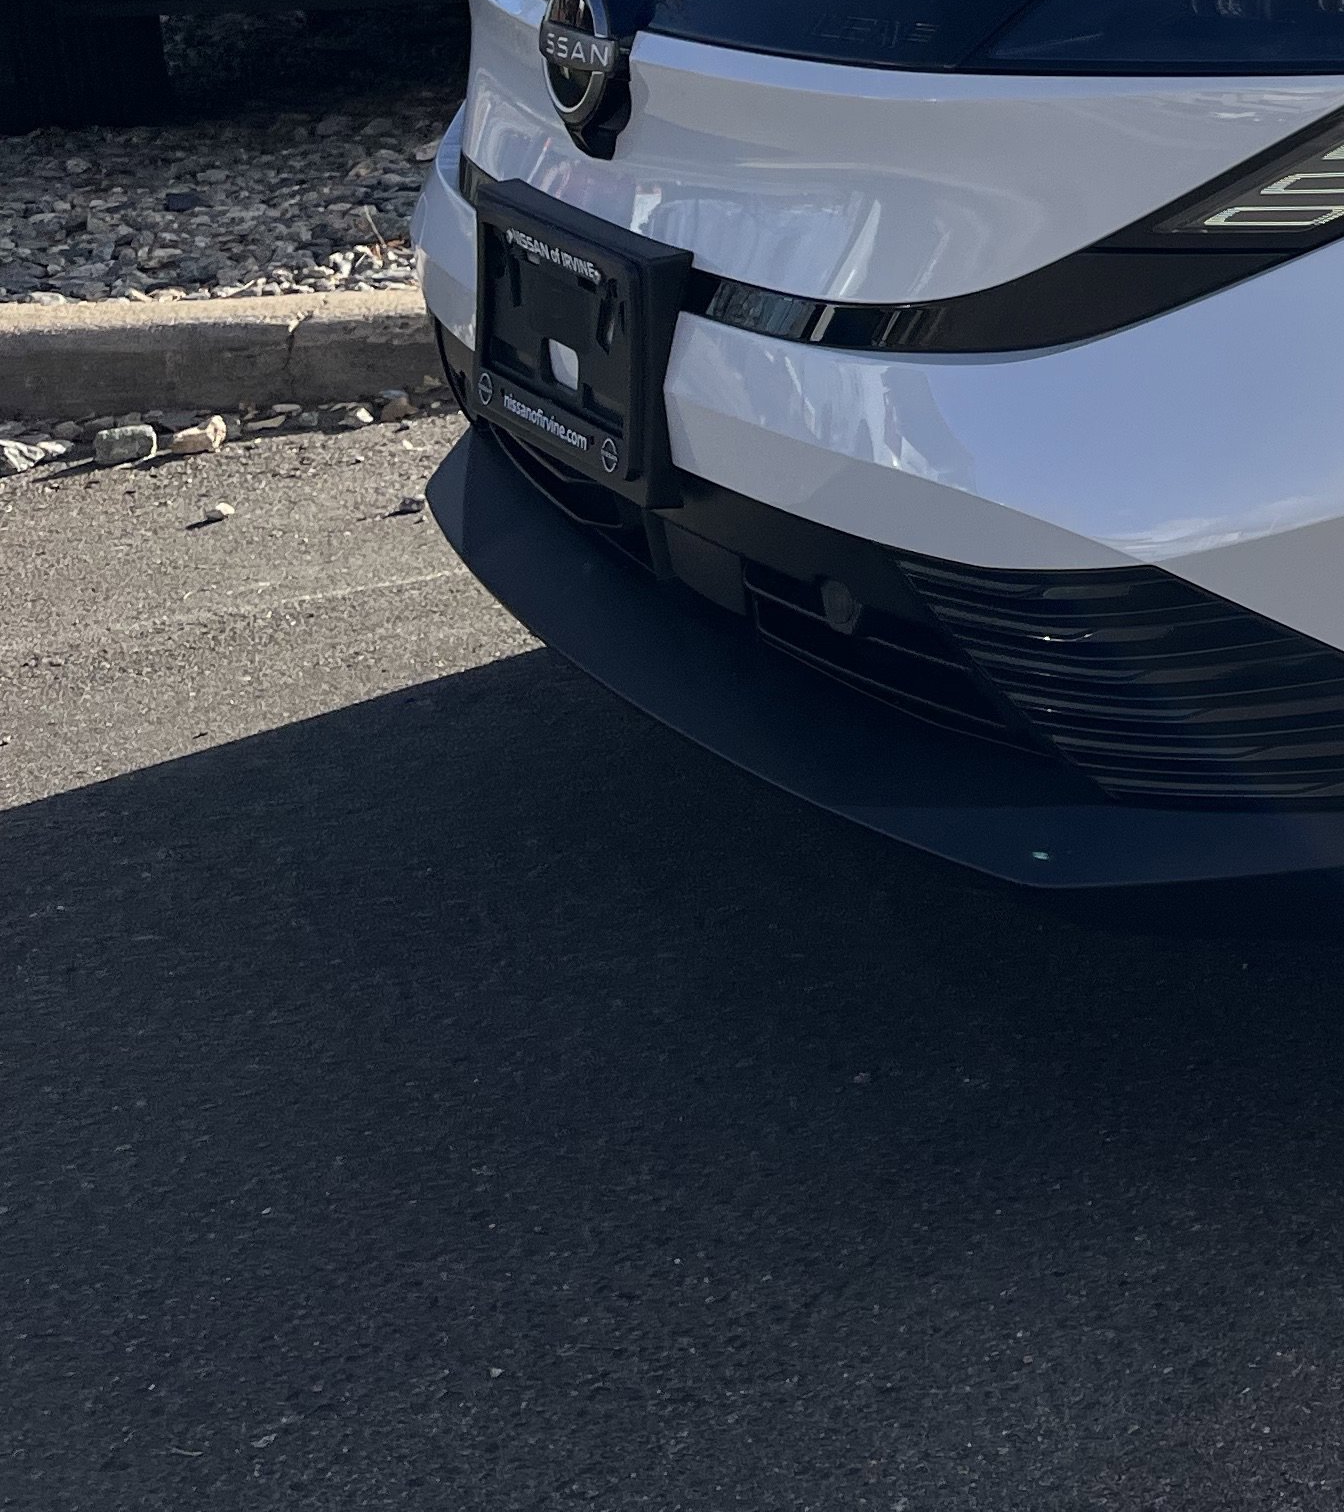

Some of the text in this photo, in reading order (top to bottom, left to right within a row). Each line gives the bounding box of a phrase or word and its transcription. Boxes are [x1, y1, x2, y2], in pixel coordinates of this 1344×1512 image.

[545, 32, 609, 67] SSAN
[511, 228, 595, 280] NISSAN of IRVINE
[503, 392, 588, 451] nissanofirvine.com
